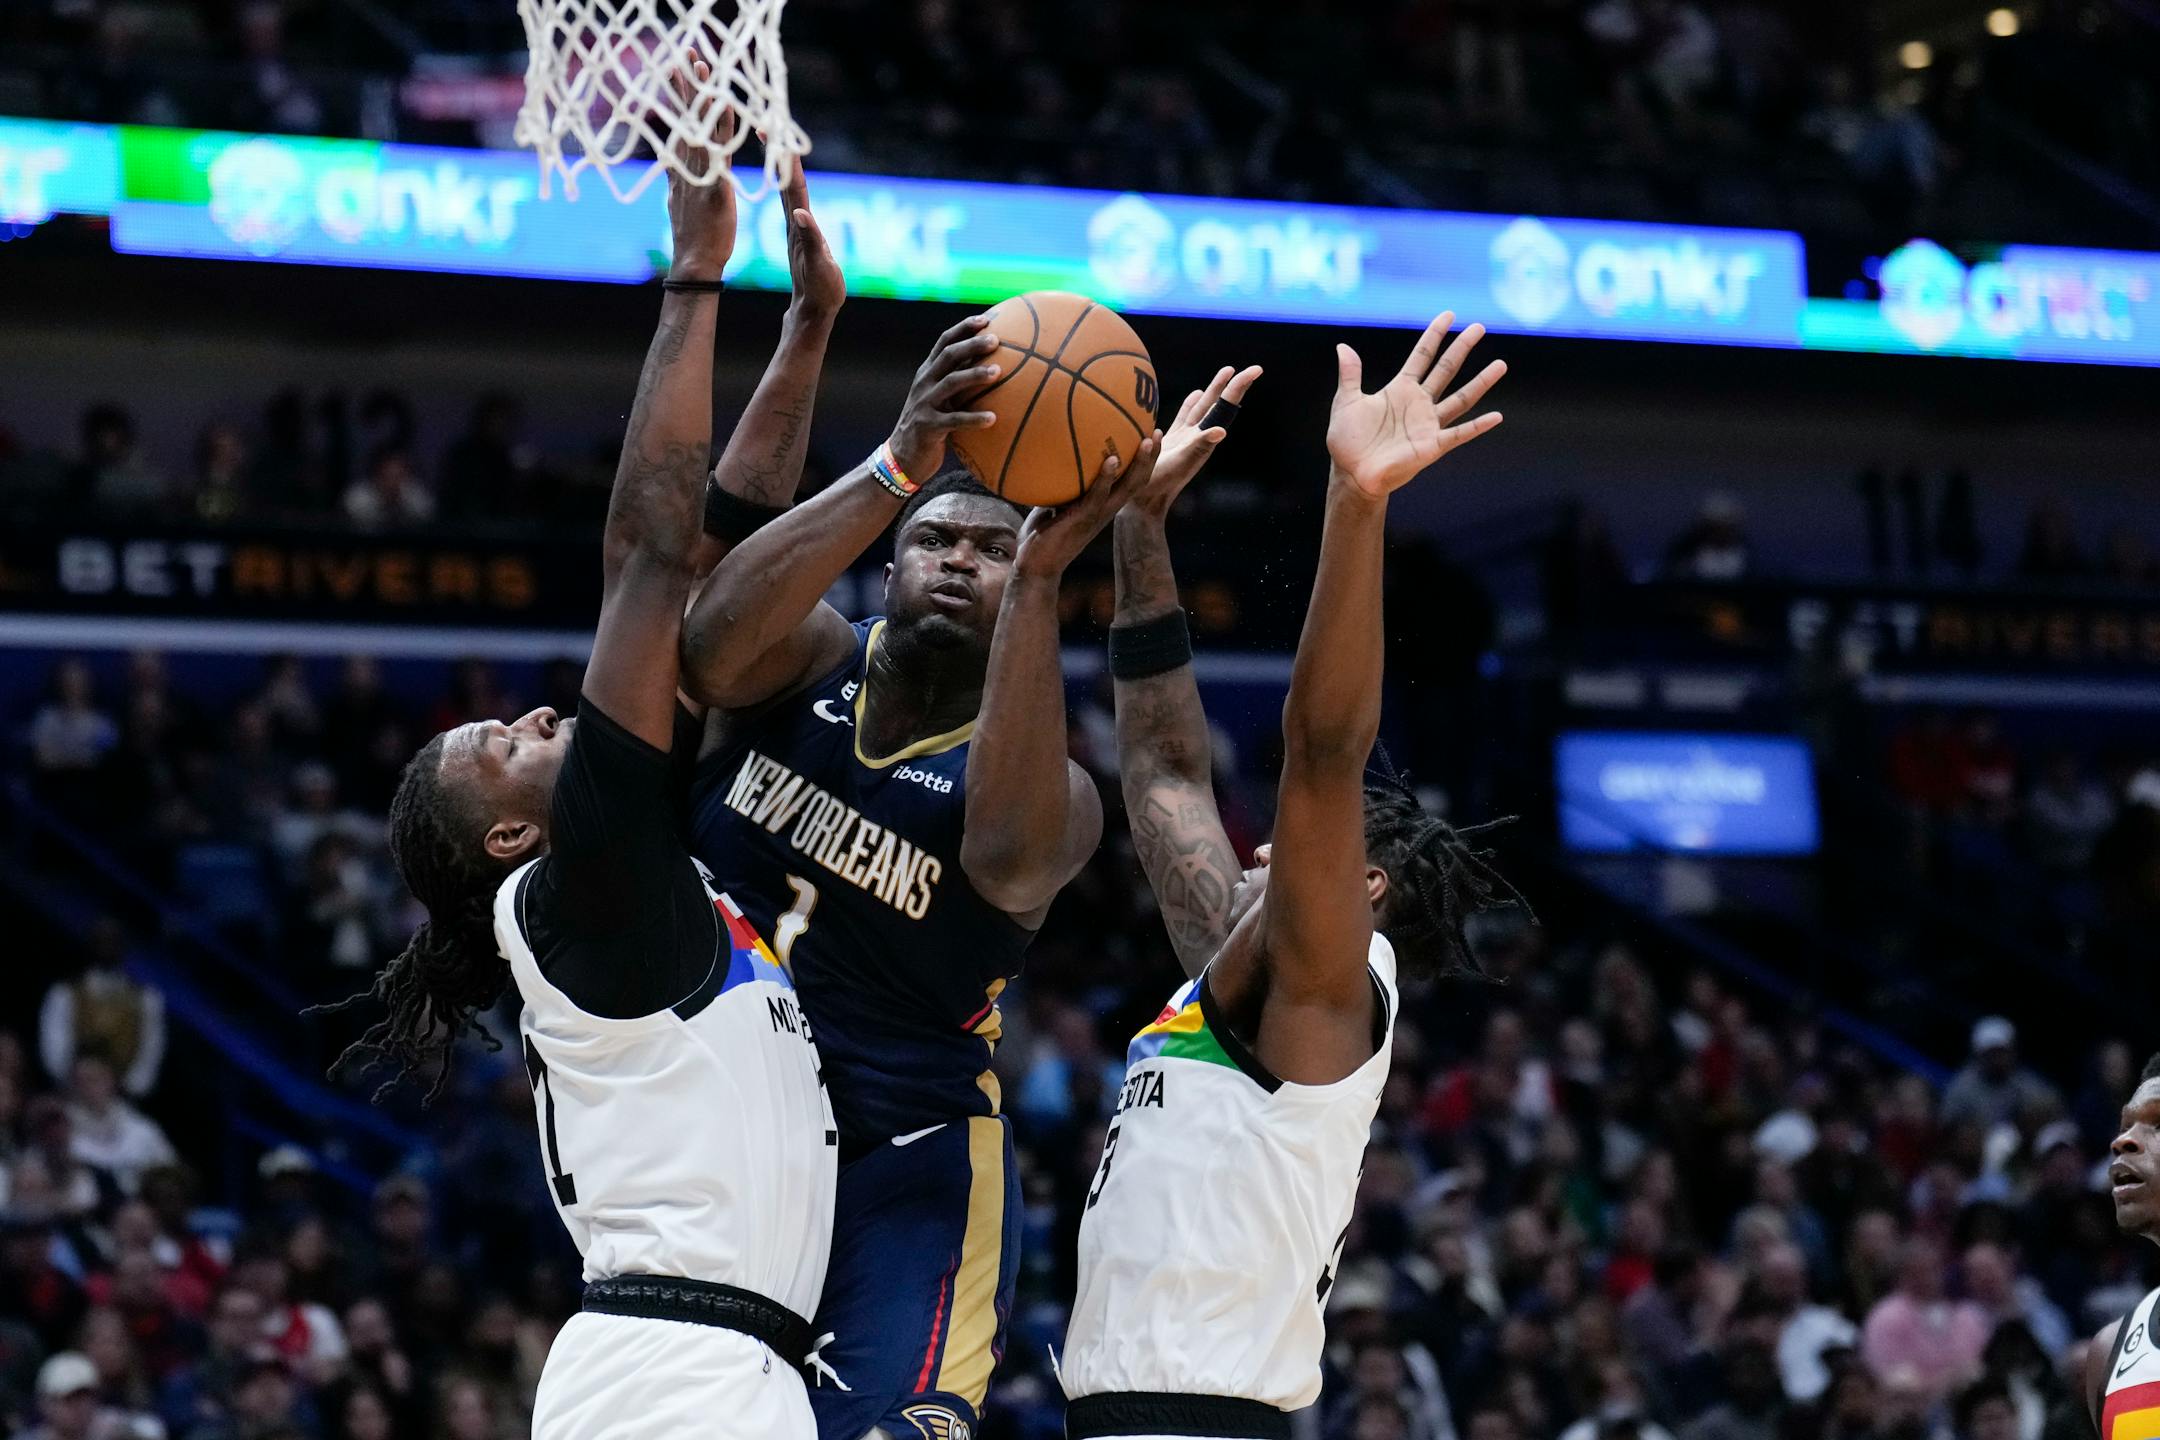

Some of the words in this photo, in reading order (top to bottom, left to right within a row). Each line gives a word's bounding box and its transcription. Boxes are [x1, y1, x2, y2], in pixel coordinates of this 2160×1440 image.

[891, 765, 953, 793] ibotta
[724, 749, 820, 834] NEW
[790, 789, 943, 921] ORLEANS
